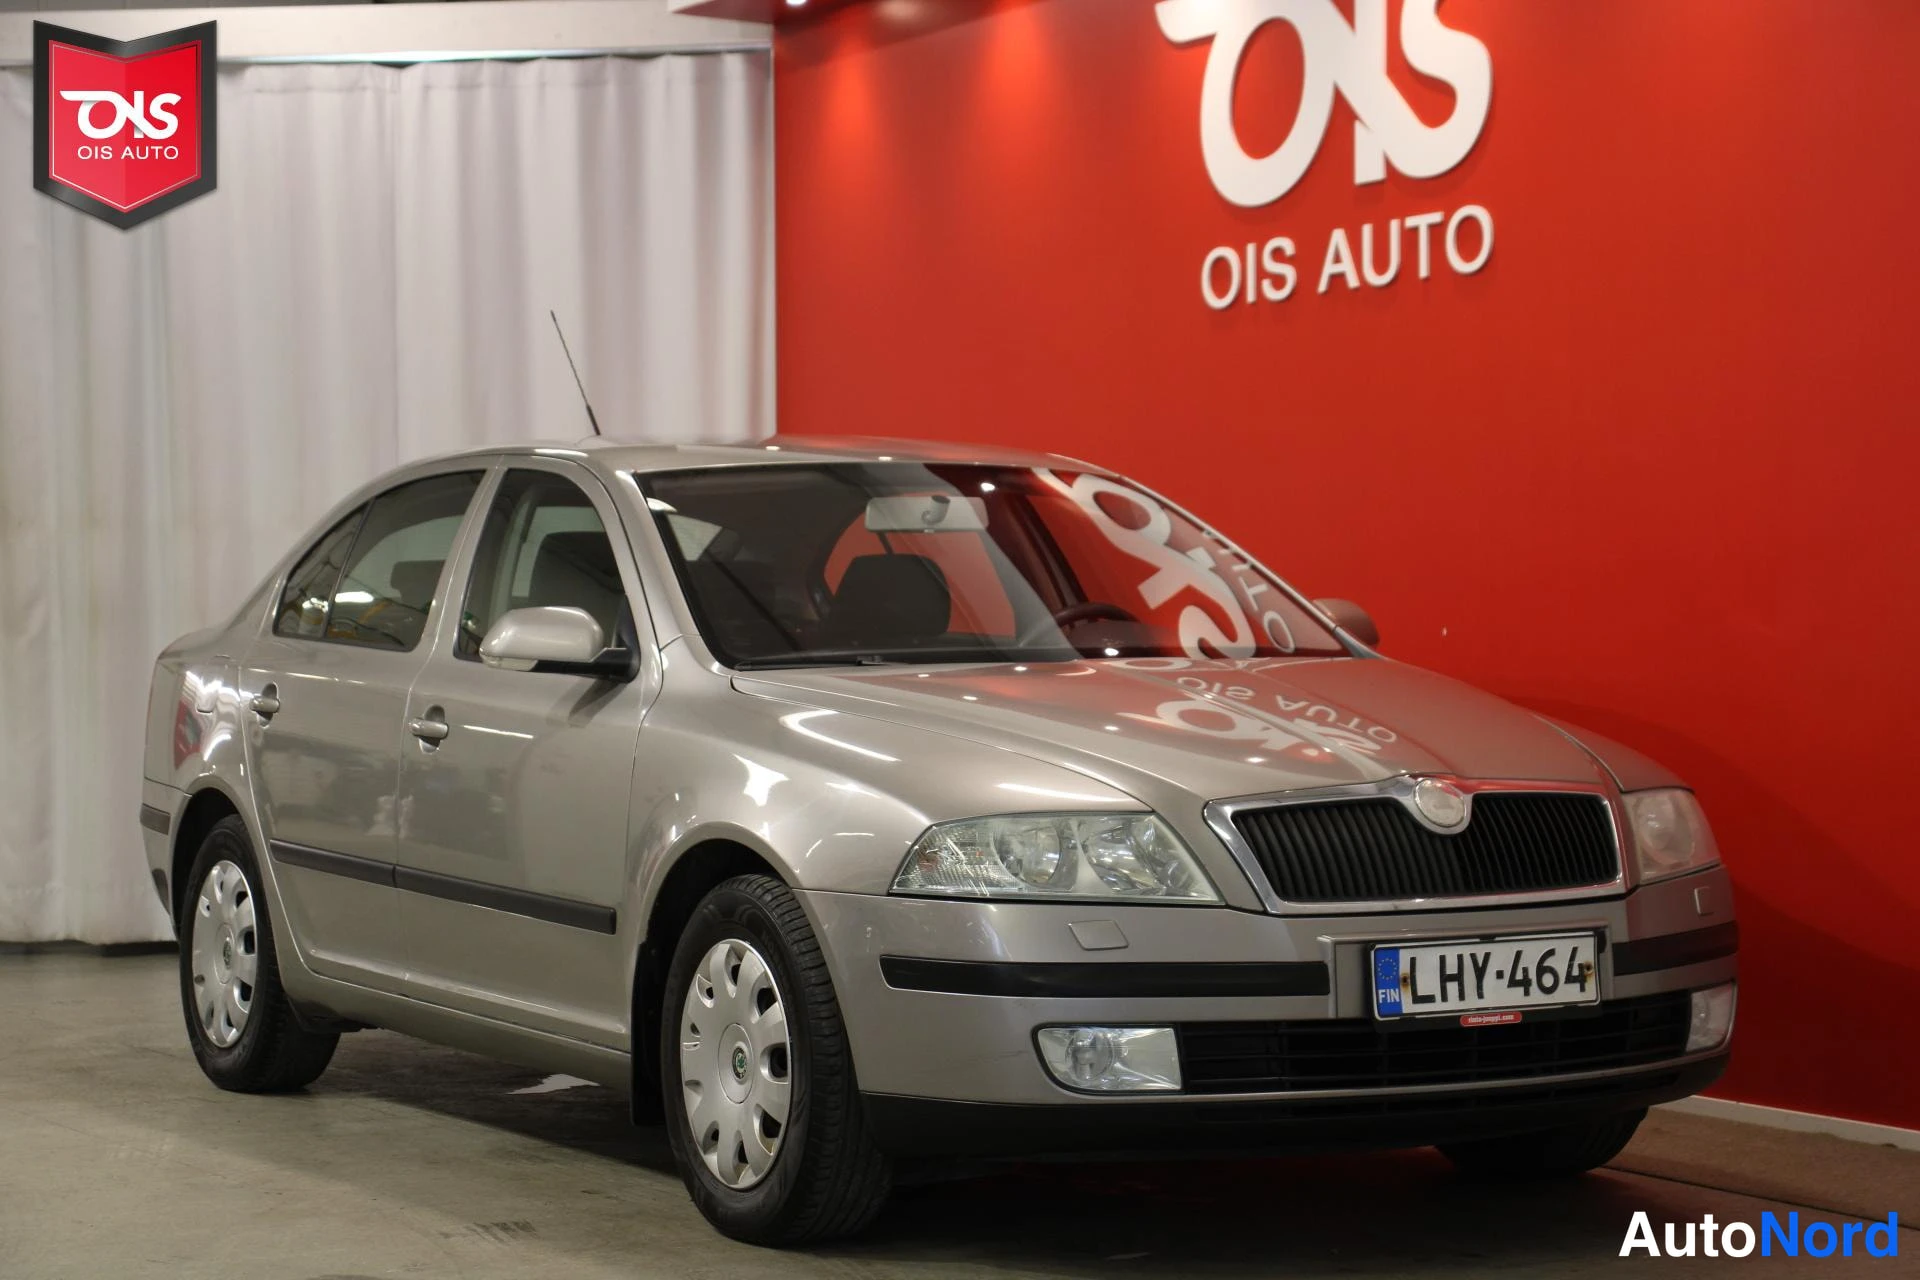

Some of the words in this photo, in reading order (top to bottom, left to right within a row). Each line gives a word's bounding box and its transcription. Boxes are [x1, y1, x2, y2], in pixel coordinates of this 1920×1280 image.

[1202, 236, 1297, 310] OIS
[1317, 205, 1494, 294] AUTO
[1378, 987, 1399, 1004] FIN
[1409, 946, 1586, 1004] LHY-464
